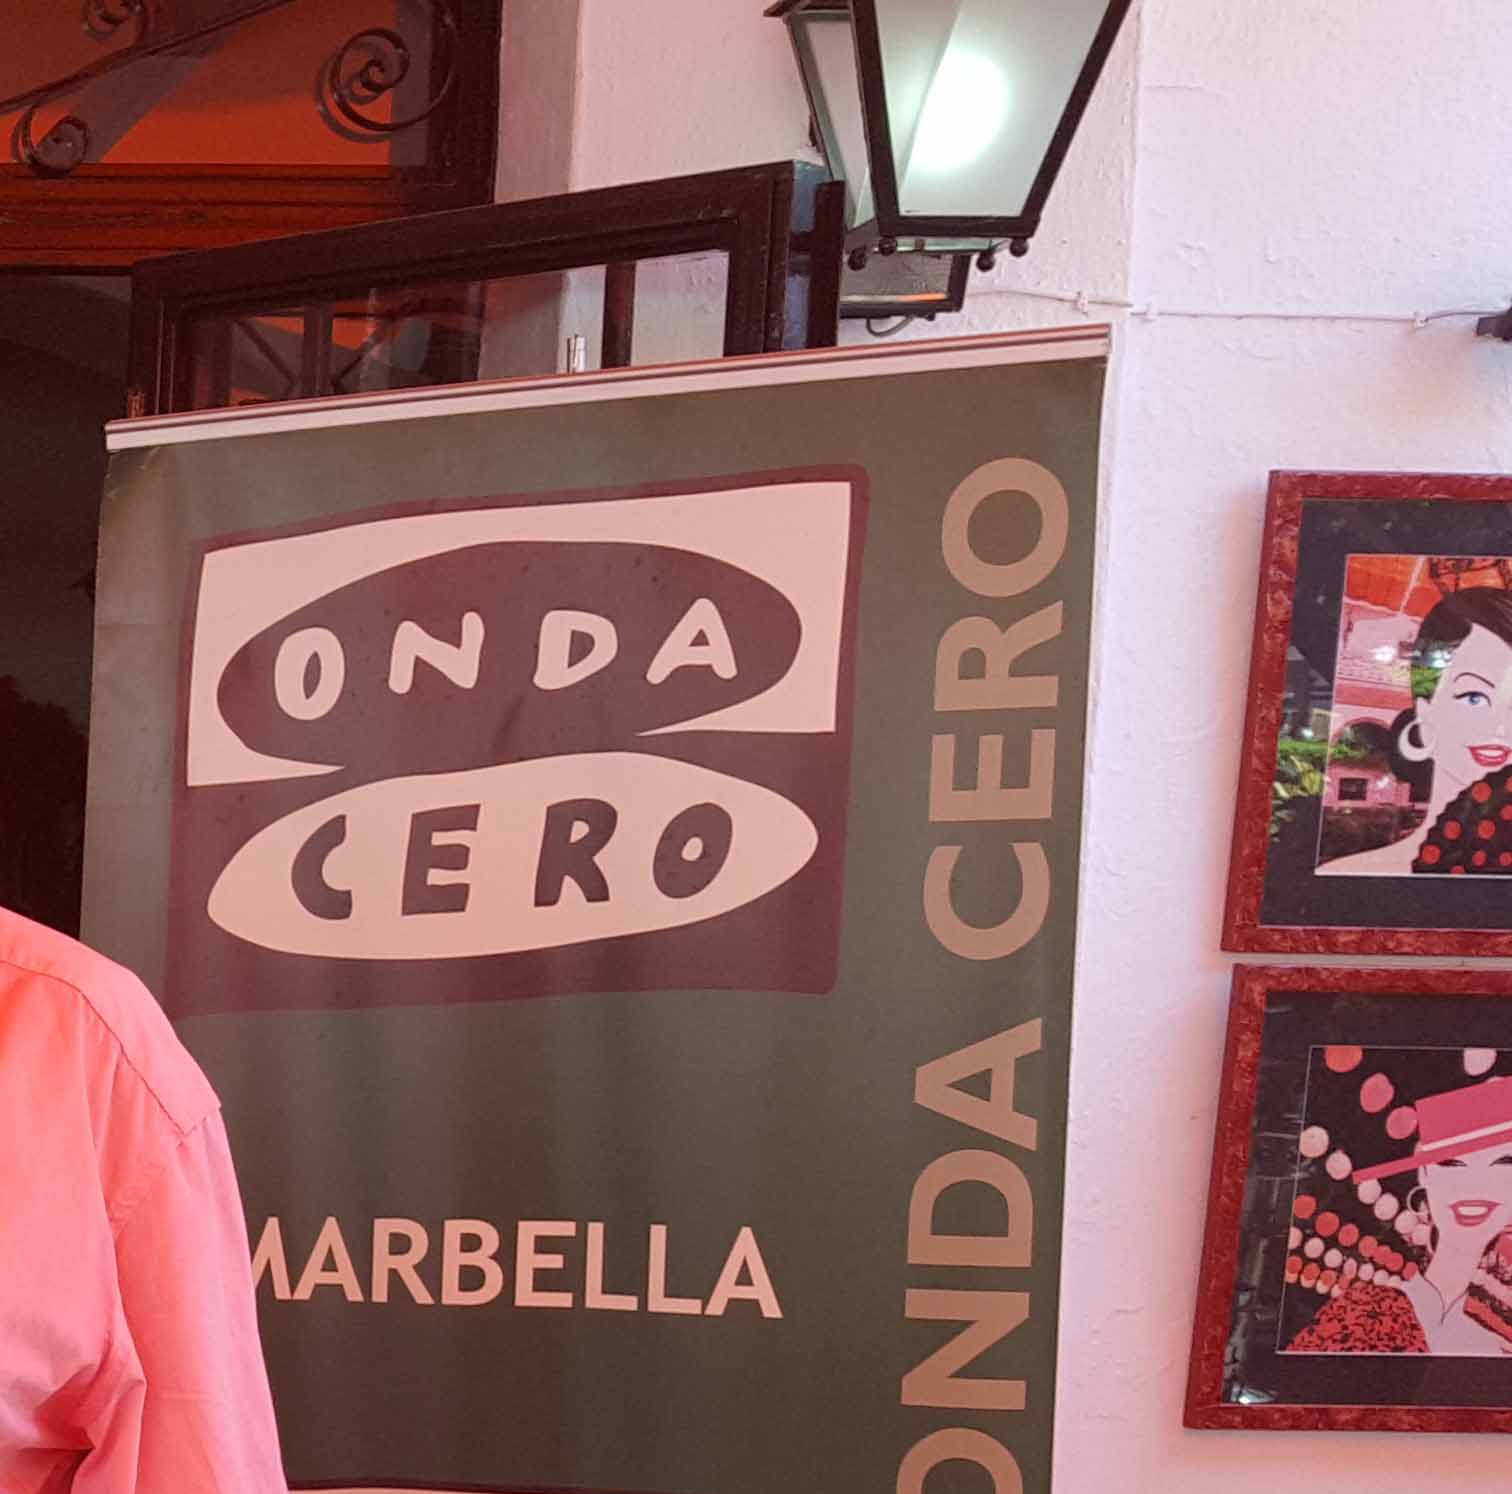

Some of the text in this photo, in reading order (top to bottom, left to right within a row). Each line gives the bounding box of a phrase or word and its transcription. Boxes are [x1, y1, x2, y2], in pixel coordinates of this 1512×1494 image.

[274, 597, 737, 721] ONDA
[922, 457, 1070, 961] CERO
[291, 798, 733, 920] CERO
[251, 1215, 783, 1319] MARBELLA
